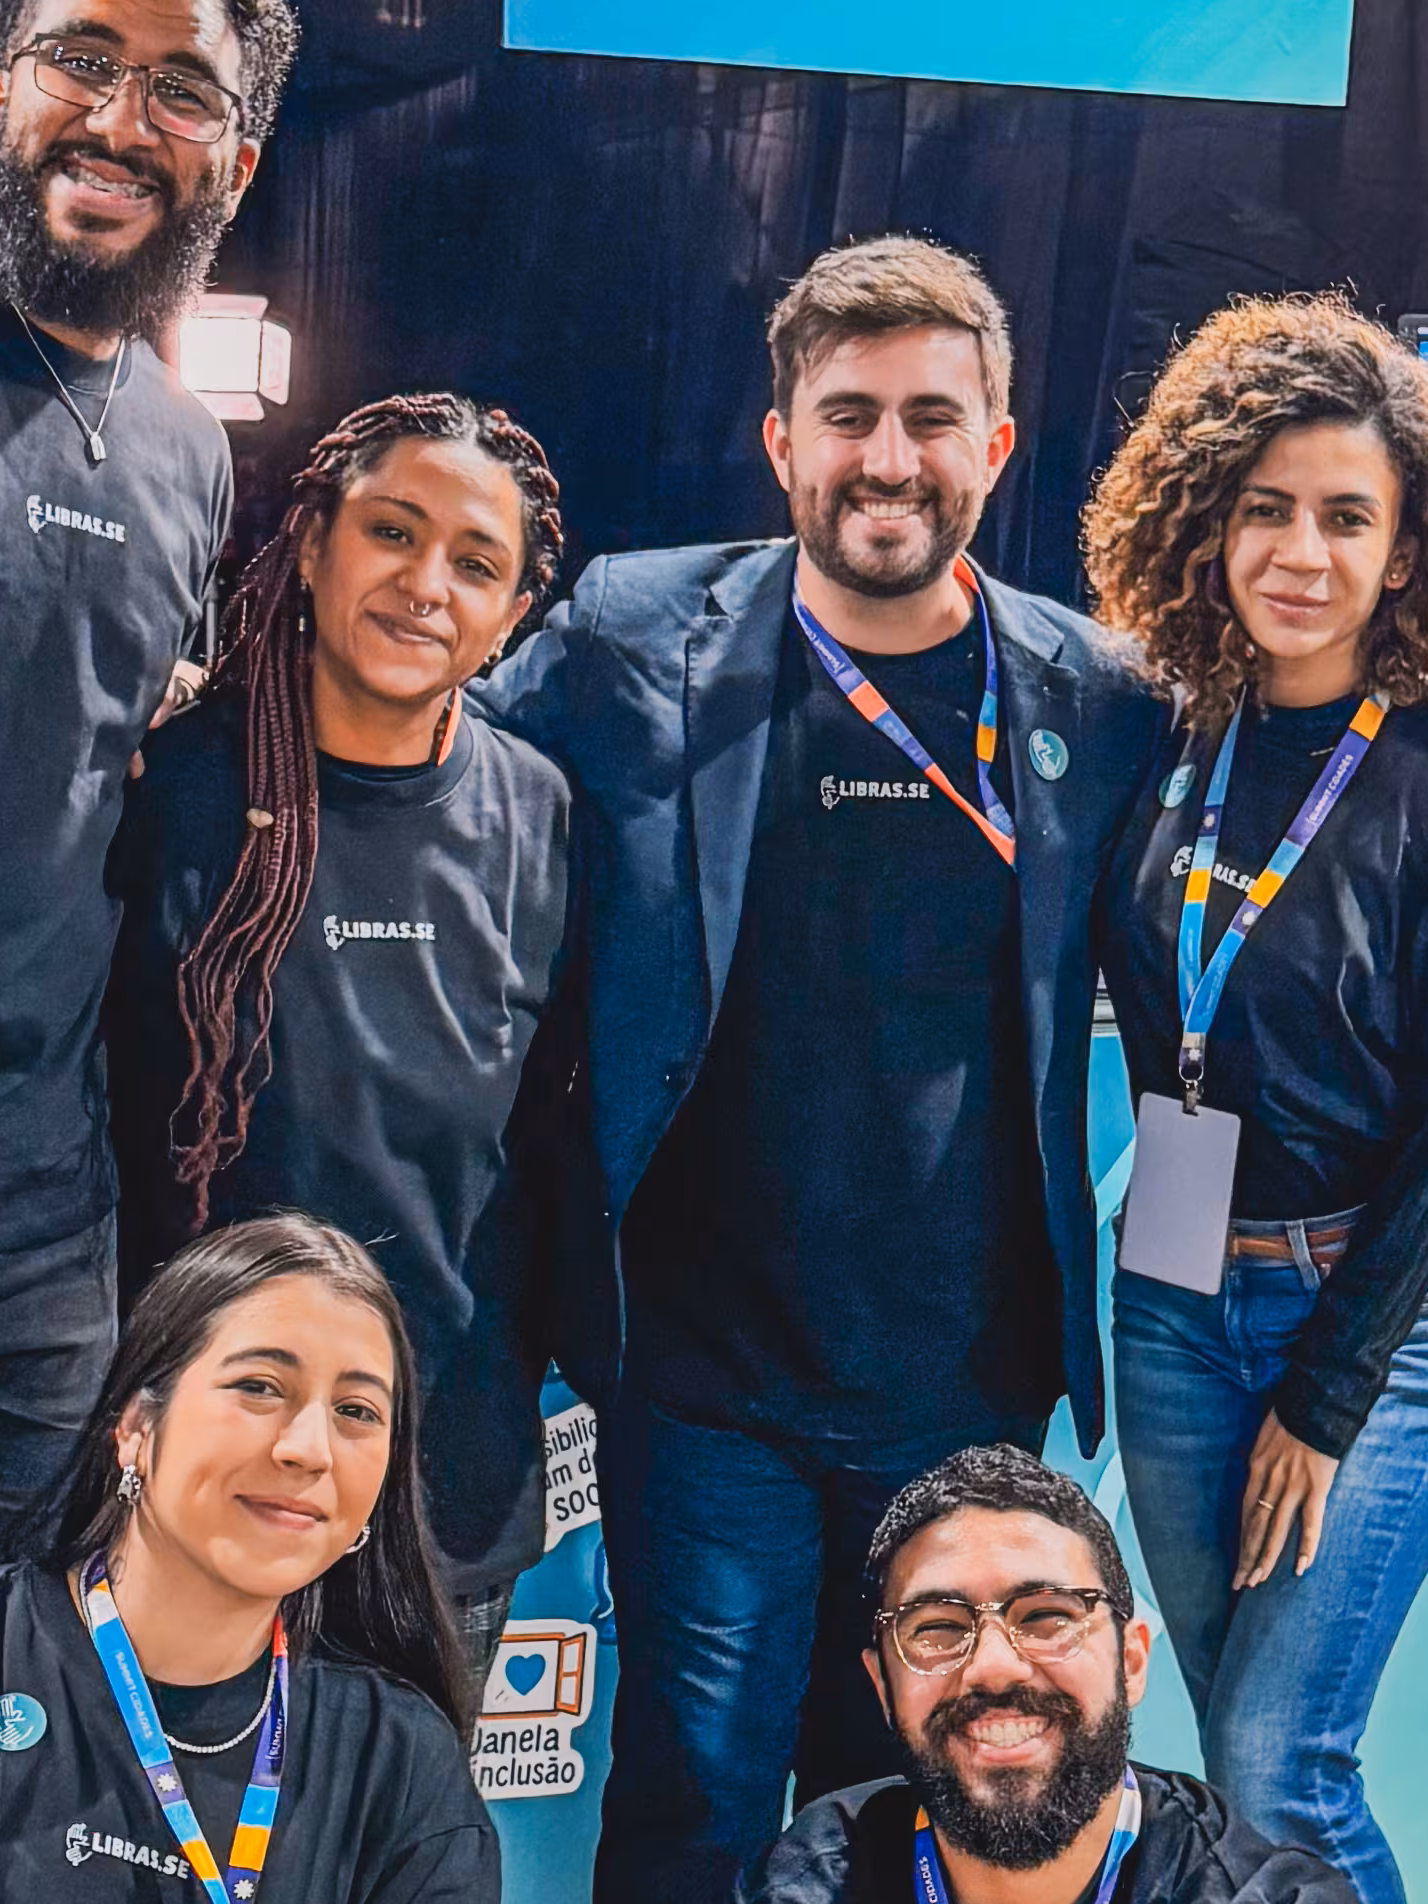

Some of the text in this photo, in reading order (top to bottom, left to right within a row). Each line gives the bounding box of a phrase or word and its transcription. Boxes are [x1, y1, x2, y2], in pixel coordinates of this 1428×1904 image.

[45, 502, 126, 543] LIBRAS.SE
[839, 780, 930, 799] LIBRAS.SE
[342, 920, 436, 941] LIBRAS.SE
[469, 1723, 560, 1757] Janela
[91, 1830, 191, 1880] LIBRAS.SE
